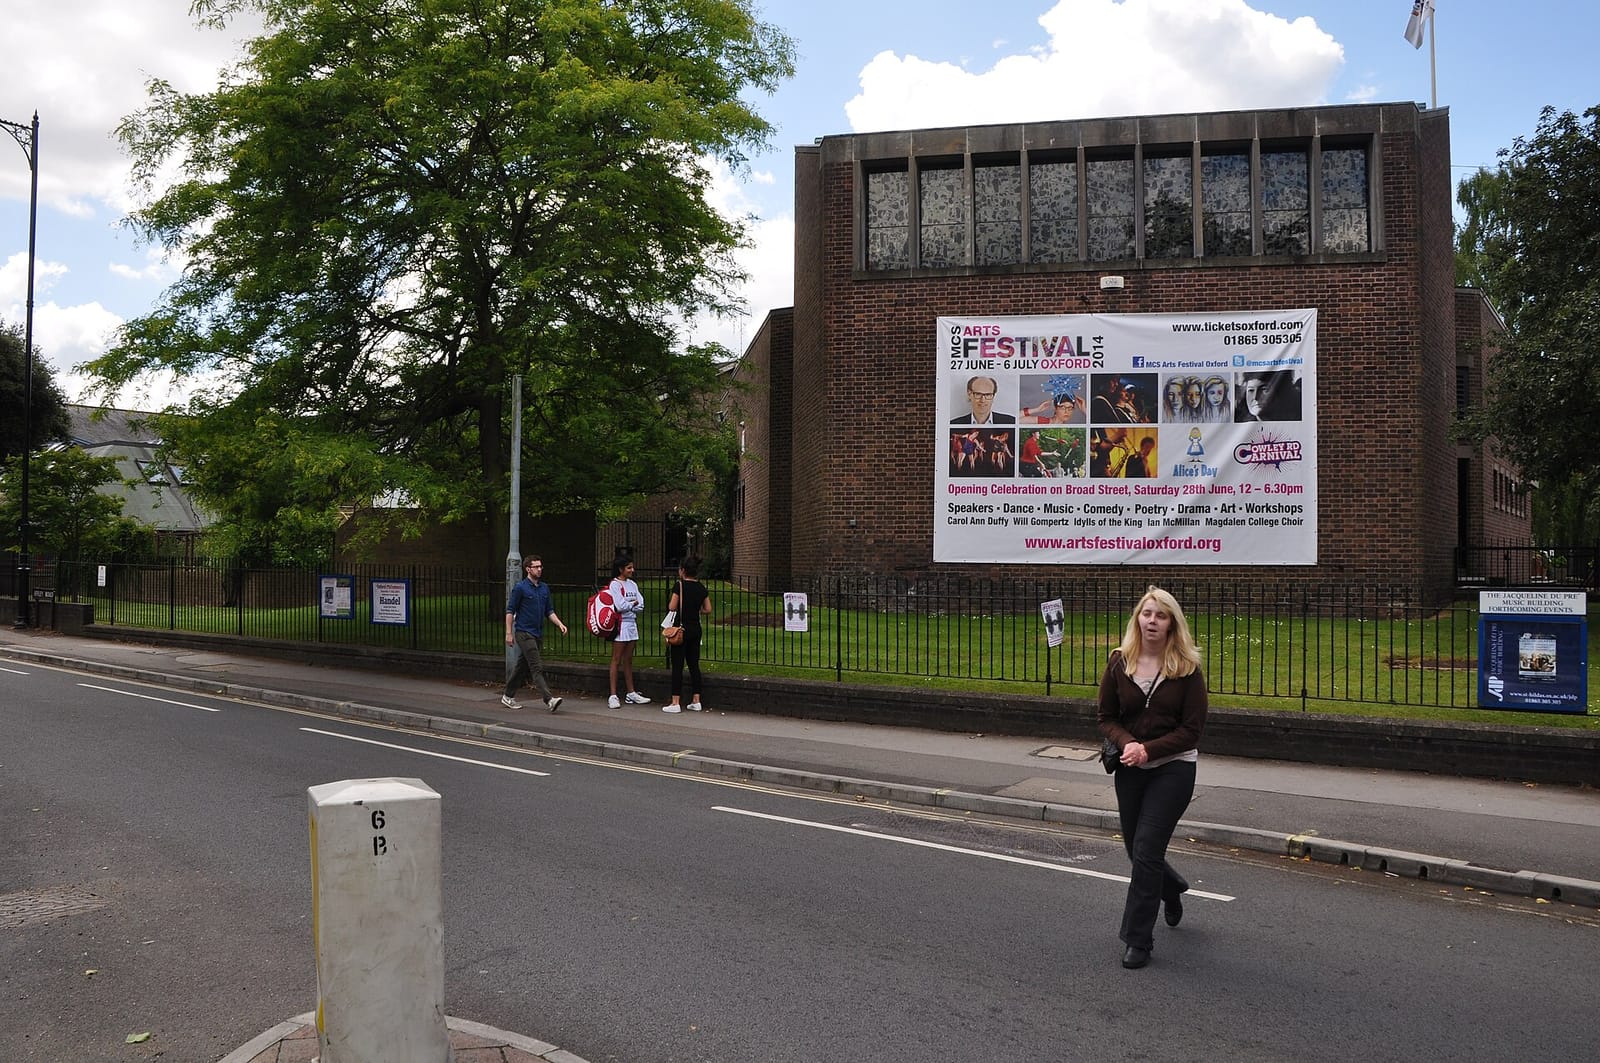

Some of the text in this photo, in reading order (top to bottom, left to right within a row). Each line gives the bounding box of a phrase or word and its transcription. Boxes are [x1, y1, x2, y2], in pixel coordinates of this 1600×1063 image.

[963, 325, 1001, 337] ARTS
[1172, 320, 1304, 332] www.ticketsoxford.com
[951, 325, 961, 358] MCS
[1223, 333, 1302, 345] 01865 305305
[963, 335, 1090, 359] FESTIVAL
[1093, 335, 1104, 368] 2014
[950, 359, 963, 370] 27
[965, 359, 994, 370] JUNE
[1003, 359, 1011, 370] 6
[1013, 359, 1039, 370] JULY
[1040, 358, 1091, 369] OXFORD
[1178, 360, 1204, 368] Festival
[1172, 464, 1218, 478] Alice's Day
[948, 483, 988, 496] Opening
[991, 484, 1047, 495] Celebration
[1050, 486, 1063, 495] on
[1065, 484, 1095, 495] Broad
[1098, 484, 1131, 497] Street,
[1134, 484, 1180, 497] Saturday
[1182, 483, 1206, 495] 28th
[1208, 483, 1236, 496] June,
[1239, 483, 1252, 494] 12
[1264, 483, 1303, 496] 6.30pm
[947, 502, 1304, 516] Speakers Dance Music Comedy Poetry Drama Art Workshops
[947, 516, 1303, 528] Carol Ann Duffy Will Gompertz Idylls of the King Ian McMillan Magdalen College Choir
[1025, 536, 1221, 552] www.artsfestivaloxford.org
[379, 596, 401, 606] Handel
[371, 810, 386, 830] 6
